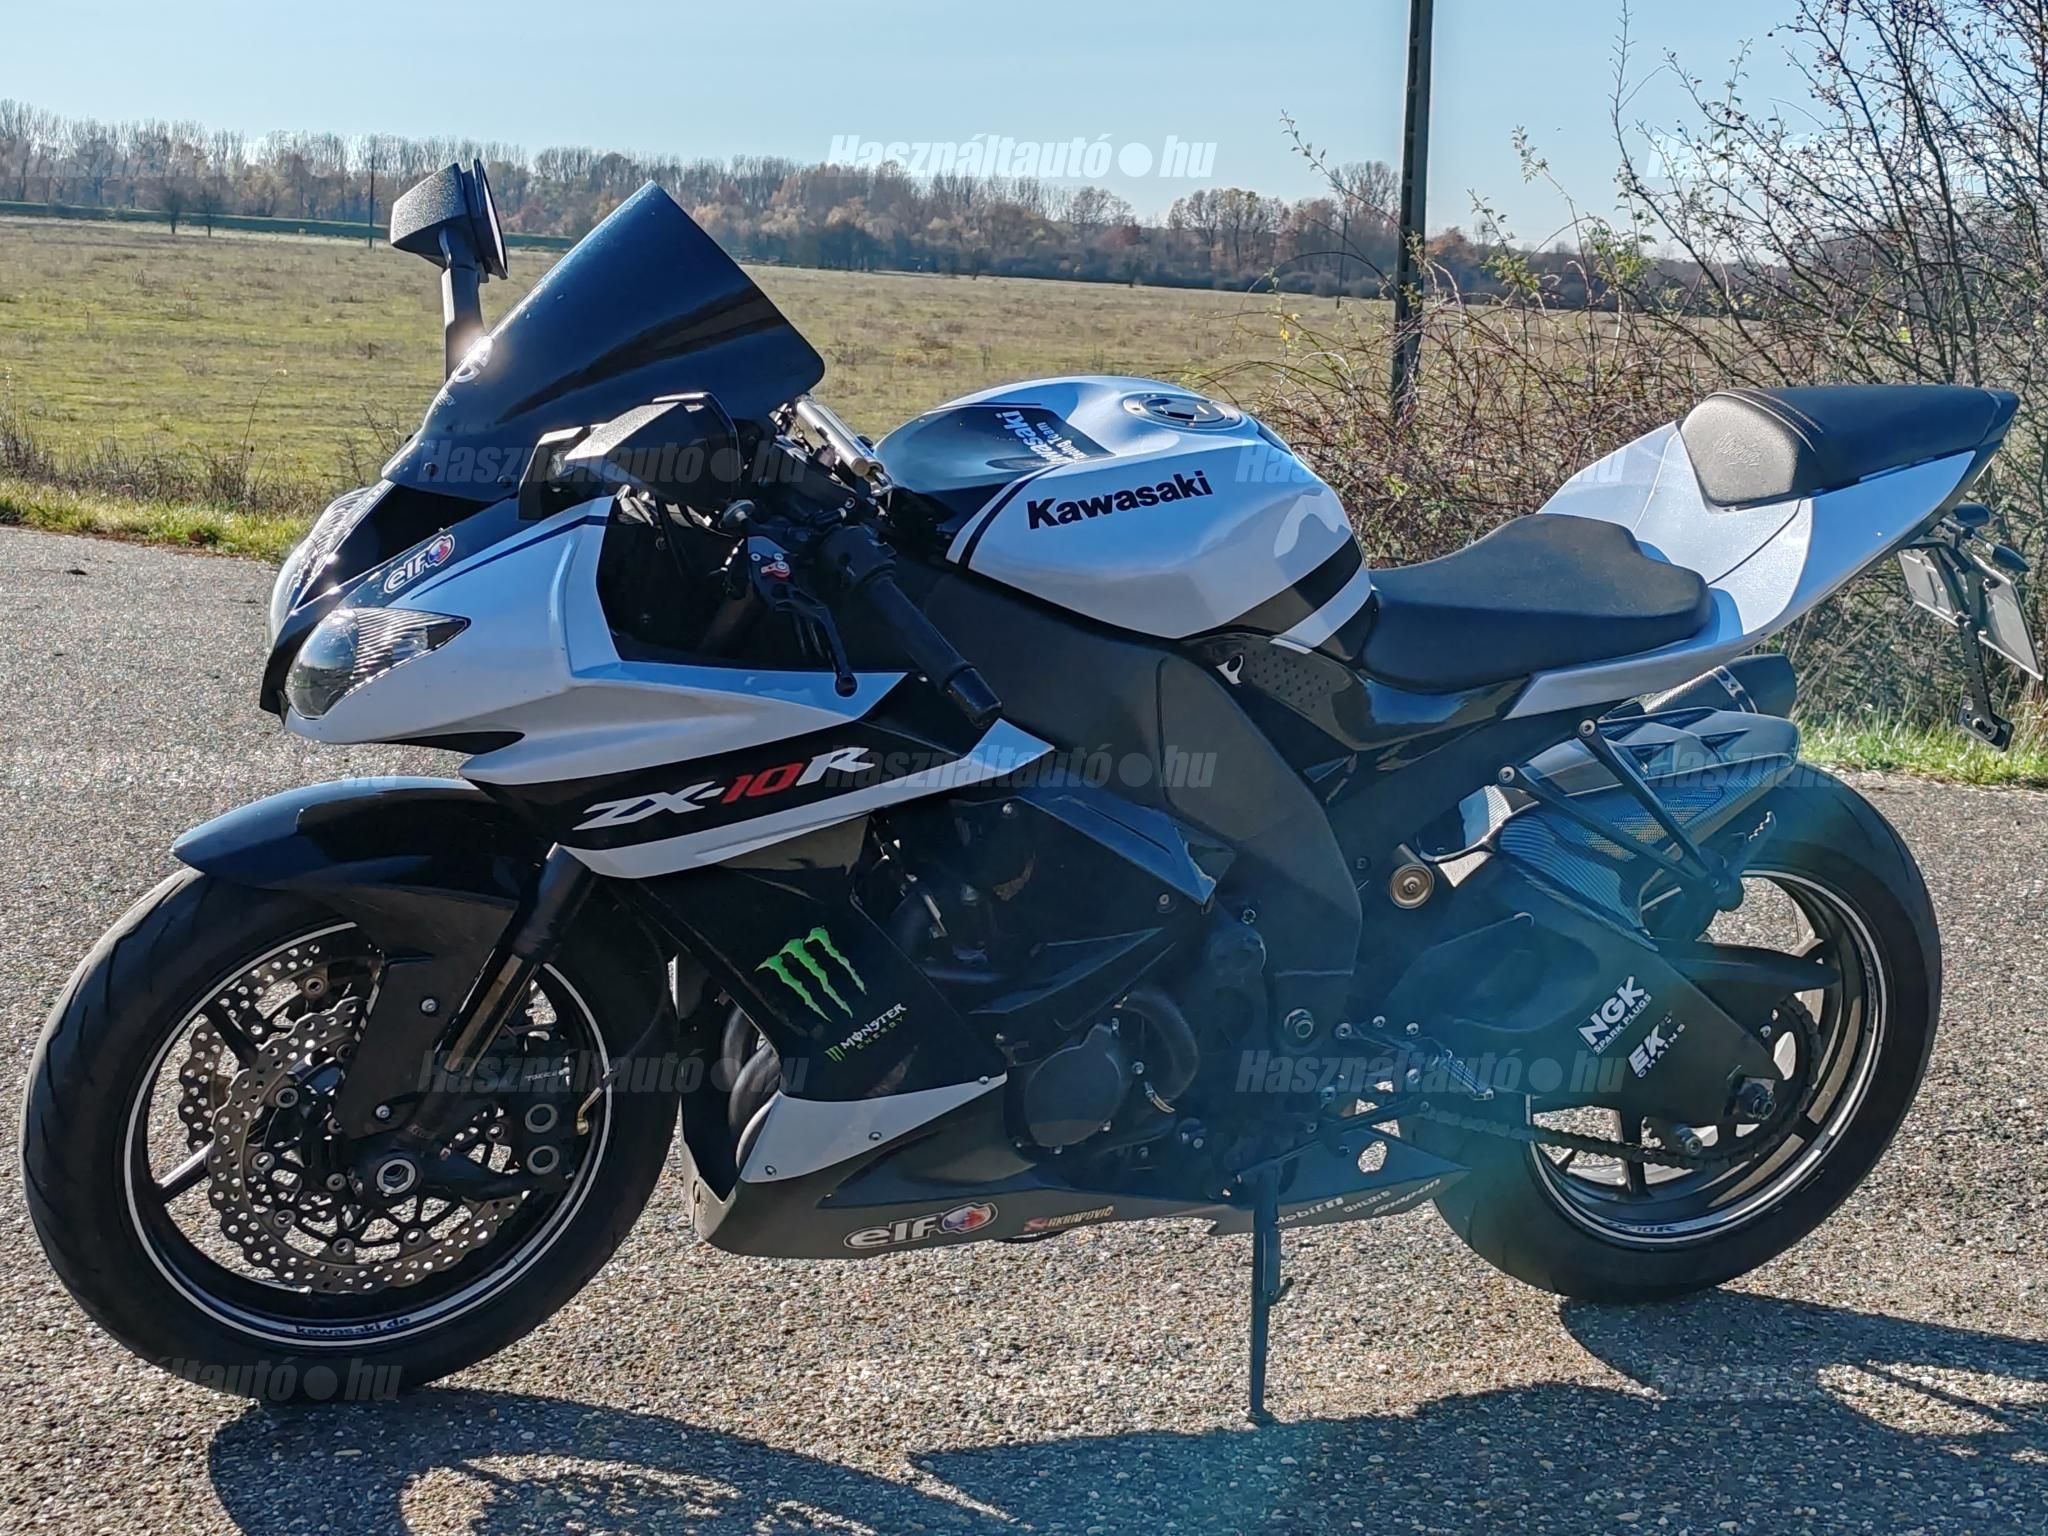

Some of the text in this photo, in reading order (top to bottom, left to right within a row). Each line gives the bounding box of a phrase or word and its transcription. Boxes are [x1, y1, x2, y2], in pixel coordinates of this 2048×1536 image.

[1026, 470, 1214, 530] Kawasaki
[387, 552, 427, 591] elf
[572, 747, 876, 831] ZX-10R
[840, 1003, 908, 1050] MONSTER
[1578, 976, 1646, 1046] NGK
[1593, 993, 1652, 1054] SPARK PLUGS
[1628, 1023, 1666, 1075] EK
[850, 1215, 938, 1247] elf
